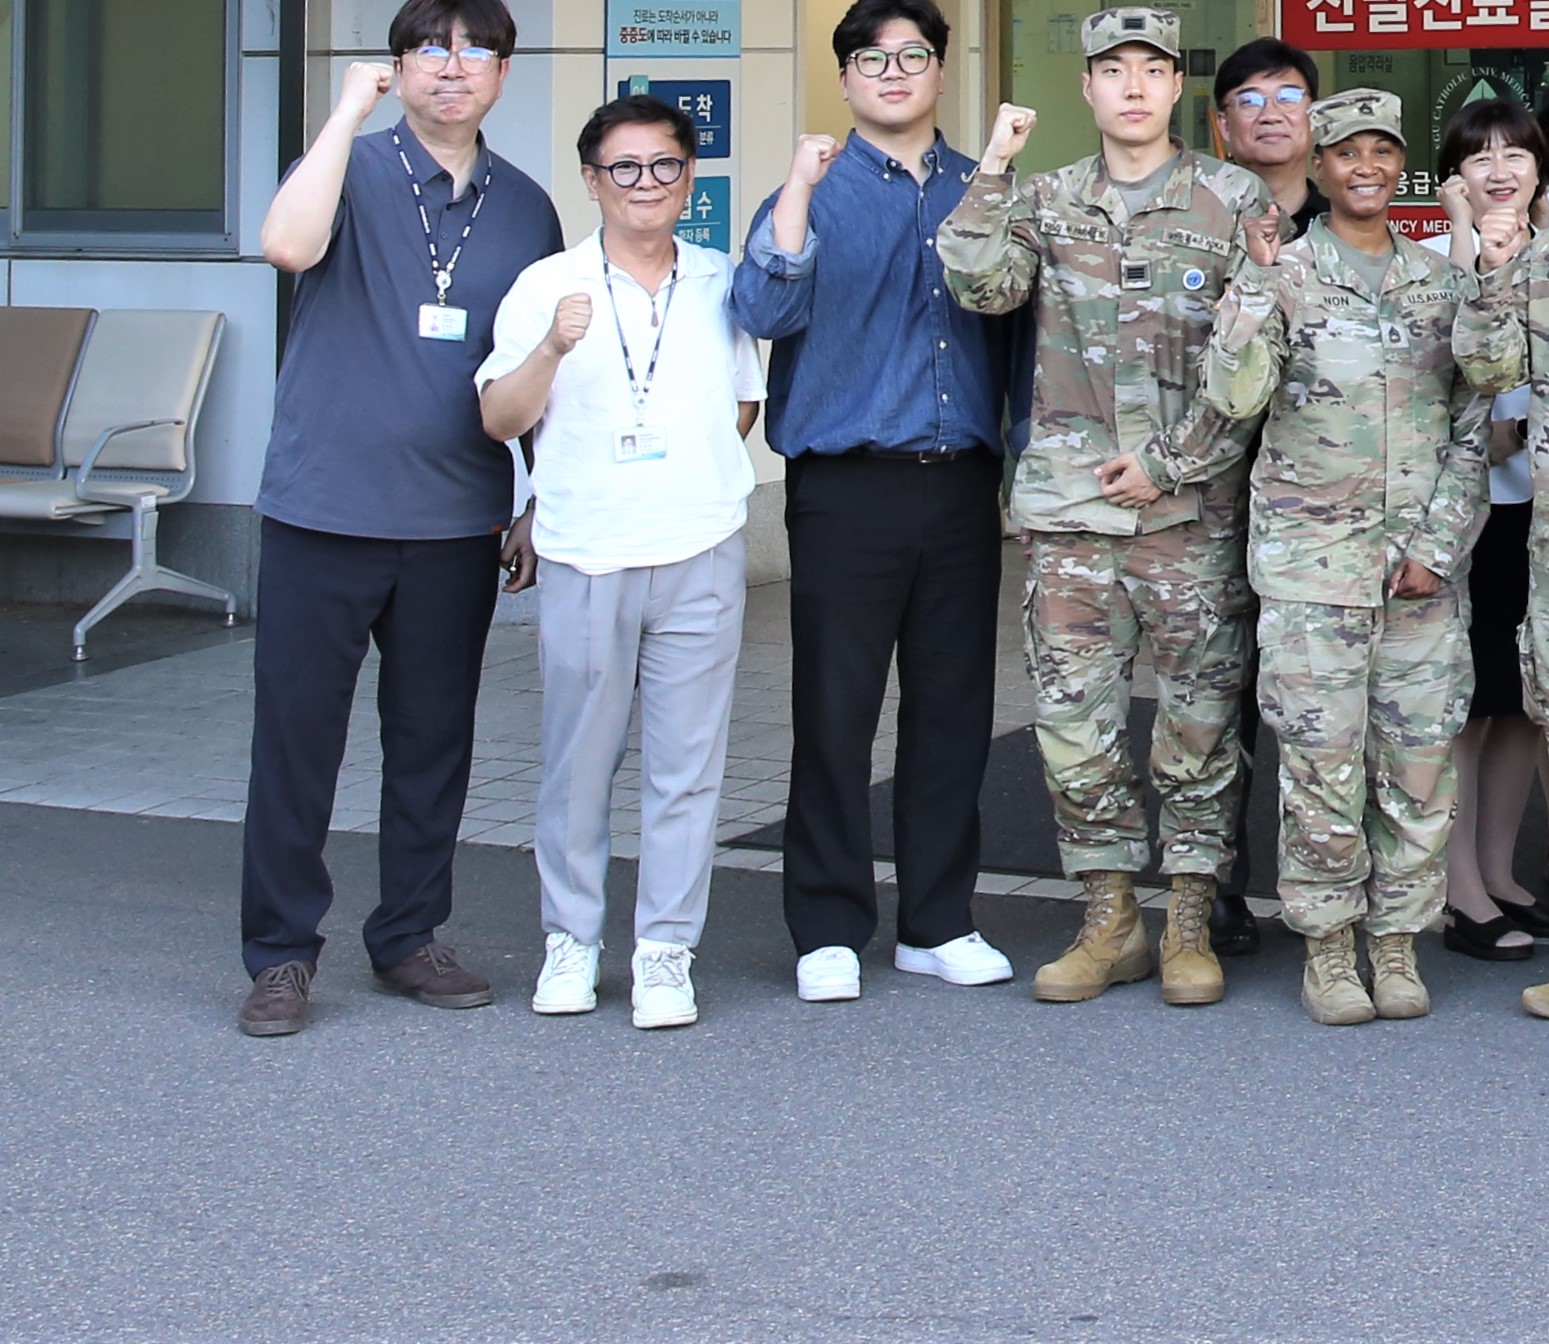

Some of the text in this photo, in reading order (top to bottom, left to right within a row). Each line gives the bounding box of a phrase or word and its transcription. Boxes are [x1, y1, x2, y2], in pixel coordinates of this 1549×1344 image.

[633, 9, 719, 24] 진료는 도착순서가 아니라
[619, 26, 732, 45] 중증도에 따라 바뀔 수 있습니다
[1432, 71, 1469, 120] CATHOLIC
[1471, 66, 1498, 78] UNIV.
